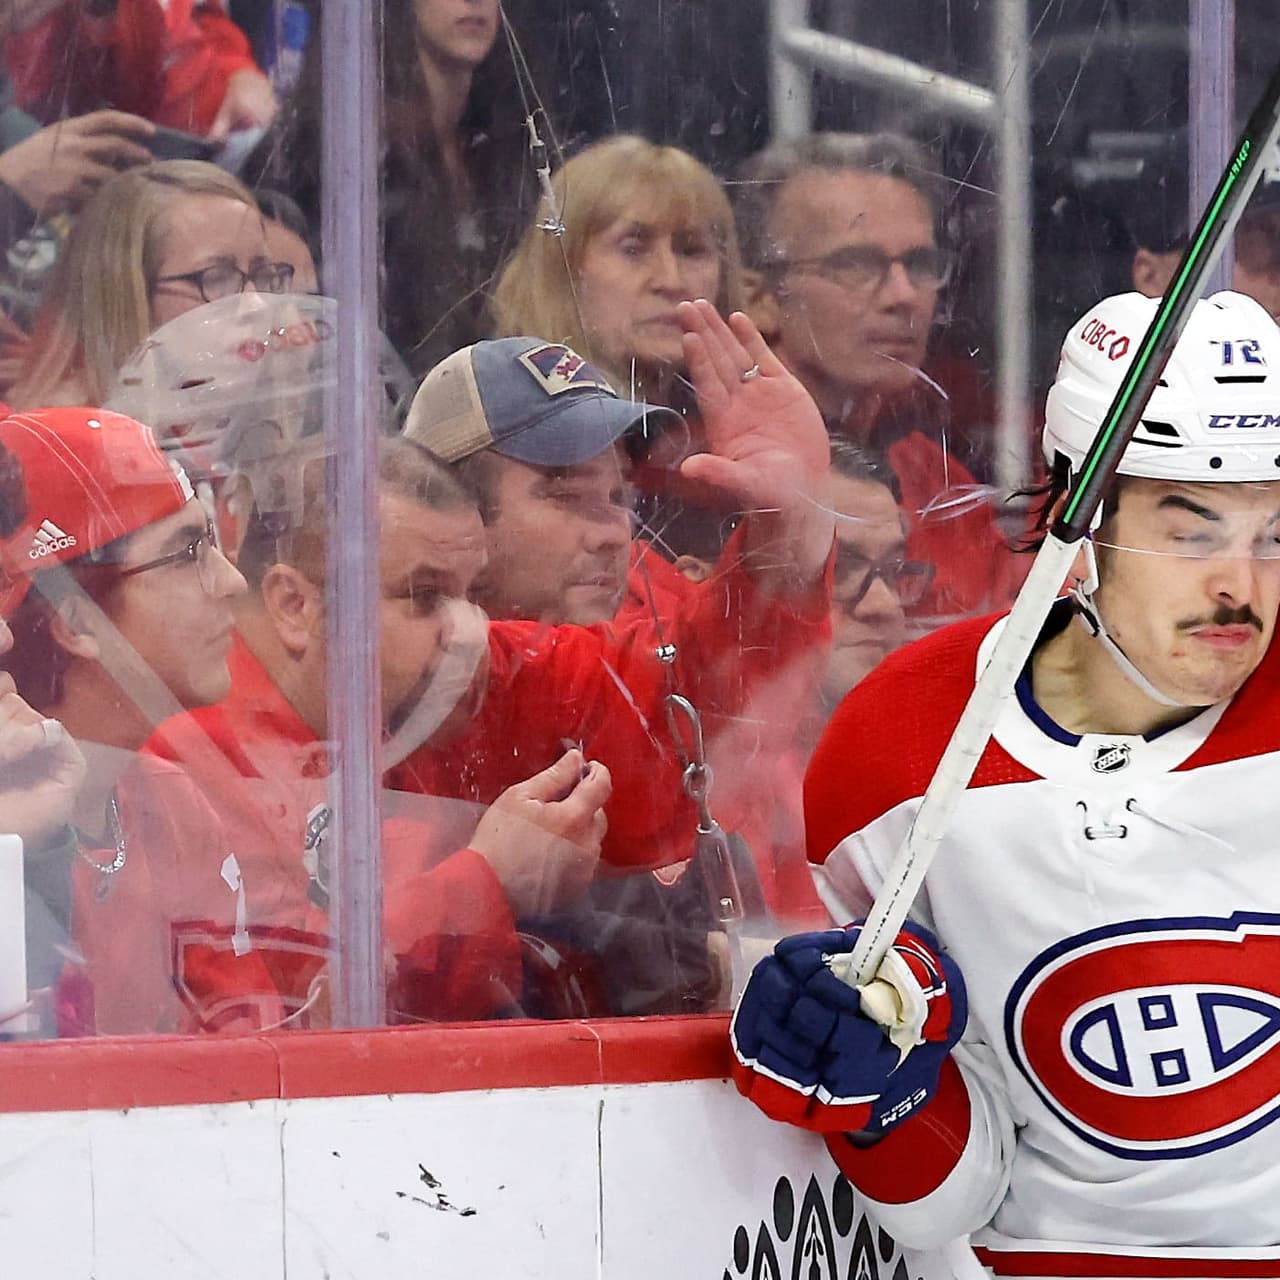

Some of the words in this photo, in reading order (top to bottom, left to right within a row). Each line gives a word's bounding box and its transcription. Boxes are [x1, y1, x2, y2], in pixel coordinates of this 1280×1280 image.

[1080, 317, 1117, 352] CIBC
[28, 535, 77, 560] adidas
[881, 1087, 928, 1128] CCM
